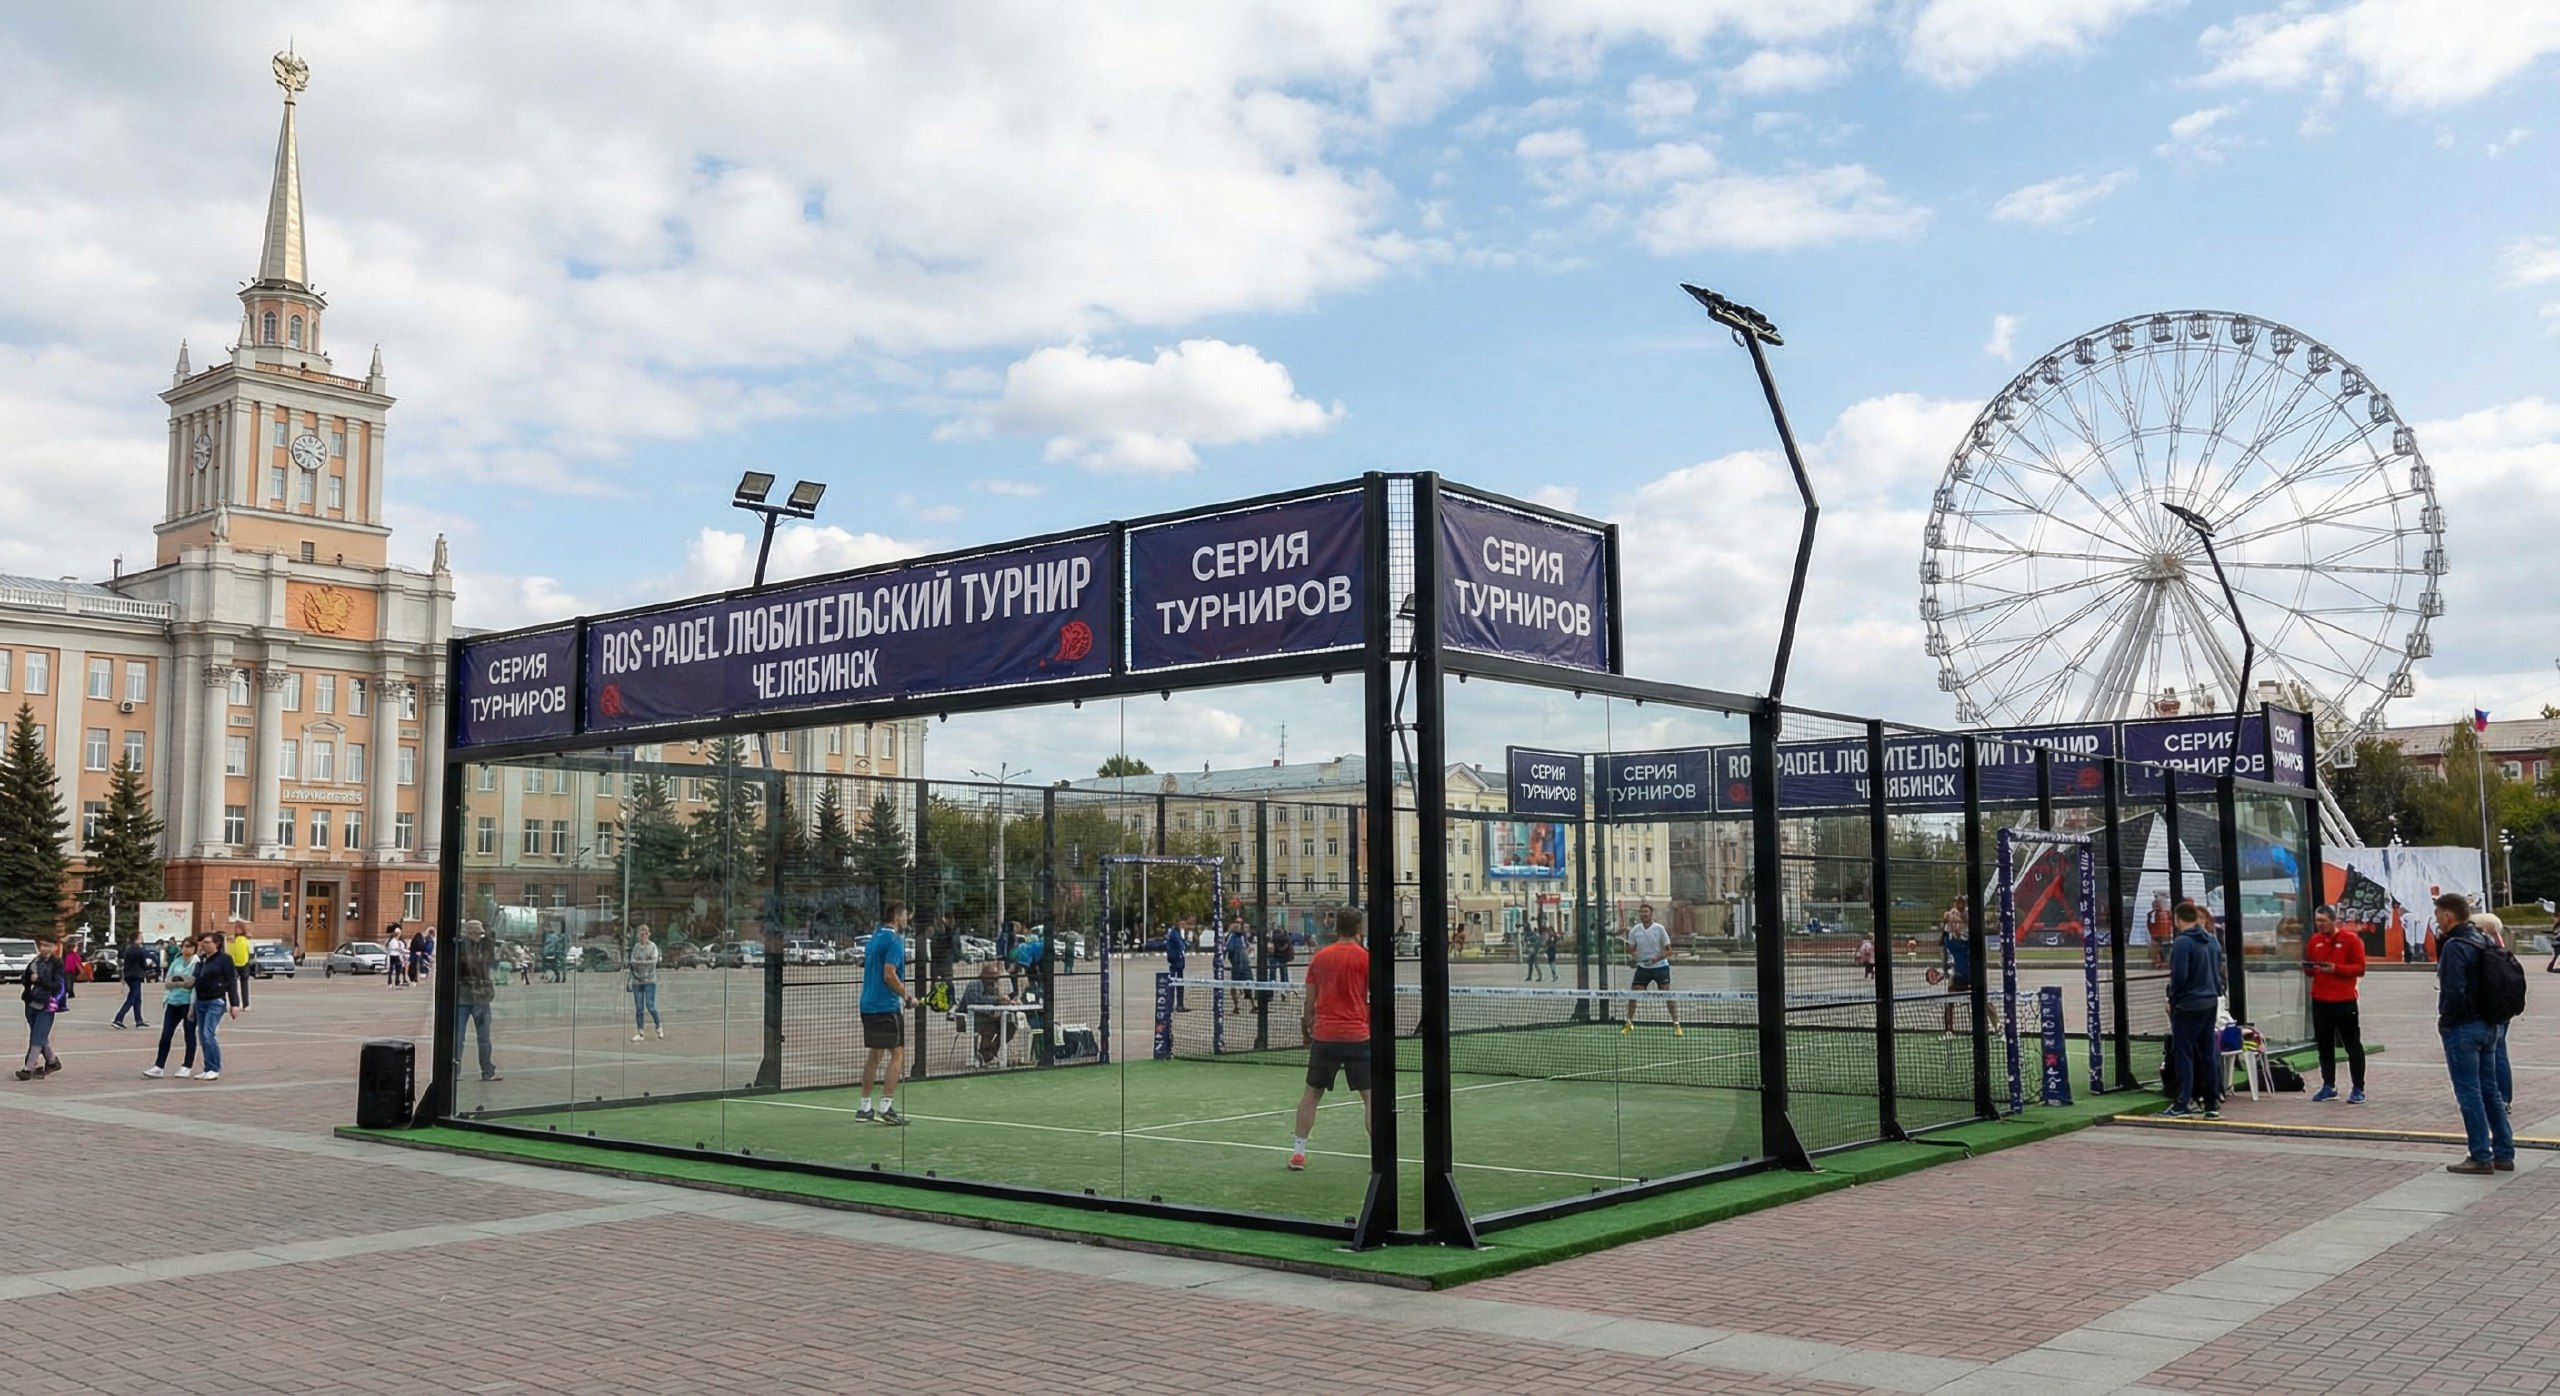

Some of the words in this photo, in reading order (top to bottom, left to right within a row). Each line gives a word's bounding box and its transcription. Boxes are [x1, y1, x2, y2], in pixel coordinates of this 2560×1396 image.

[1192, 530, 1310, 582] СЕРИЯ
[1483, 535, 1564, 586] СЕРИЯ
[602, 615, 720, 675] ROS-PADEL
[724, 571, 952, 658] ЛЮБИТЕЛЬСКИЙ
[961, 556, 1092, 625] ТУРНИР
[1156, 575, 1352, 635] ТУРНИРОВ
[1455, 578, 1591, 637] ТУРНИРОВ
[488, 652, 547, 685] СЕРИЯ
[751, 648, 879, 700] ЧЕЛЯБИНСК
[471, 686, 566, 723] ТУРНИРОВ
[1531, 764, 1566, 781] СЕРИЯ
[1623, 763, 1677, 781] СЕРИЯ
[1834, 734, 2004, 773] ЛЮИТЕЛЬСИЙ
[1520, 783, 1577, 802] ТУРНИРОВ
[1606, 783, 1697, 802] ТУРНИРОВ
